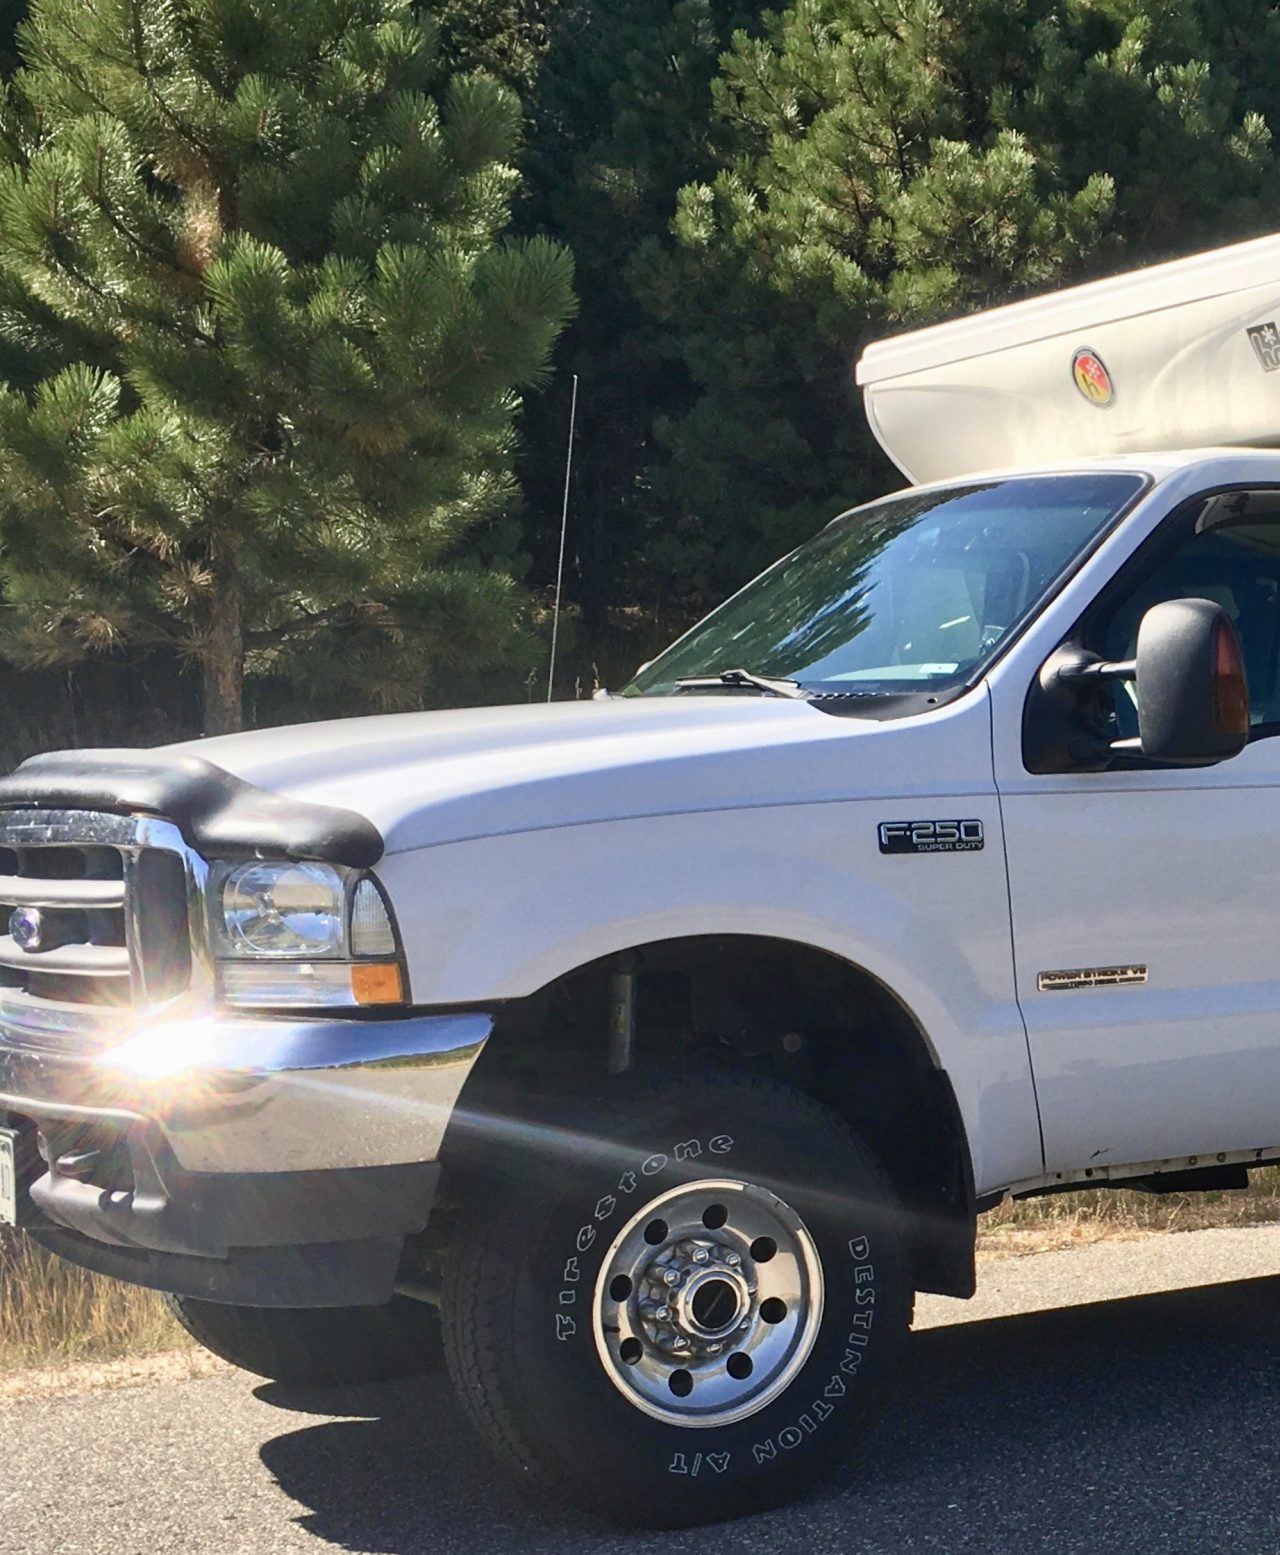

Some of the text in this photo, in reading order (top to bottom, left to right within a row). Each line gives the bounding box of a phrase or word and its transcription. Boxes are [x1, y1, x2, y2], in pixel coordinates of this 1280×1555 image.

[917, 842, 983, 850] SUPER DUTY
[1041, 972, 1081, 981] POWER
[556, 1135, 734, 1340] Firestone
[669, 1236, 875, 1477] DESTINATION A/T
